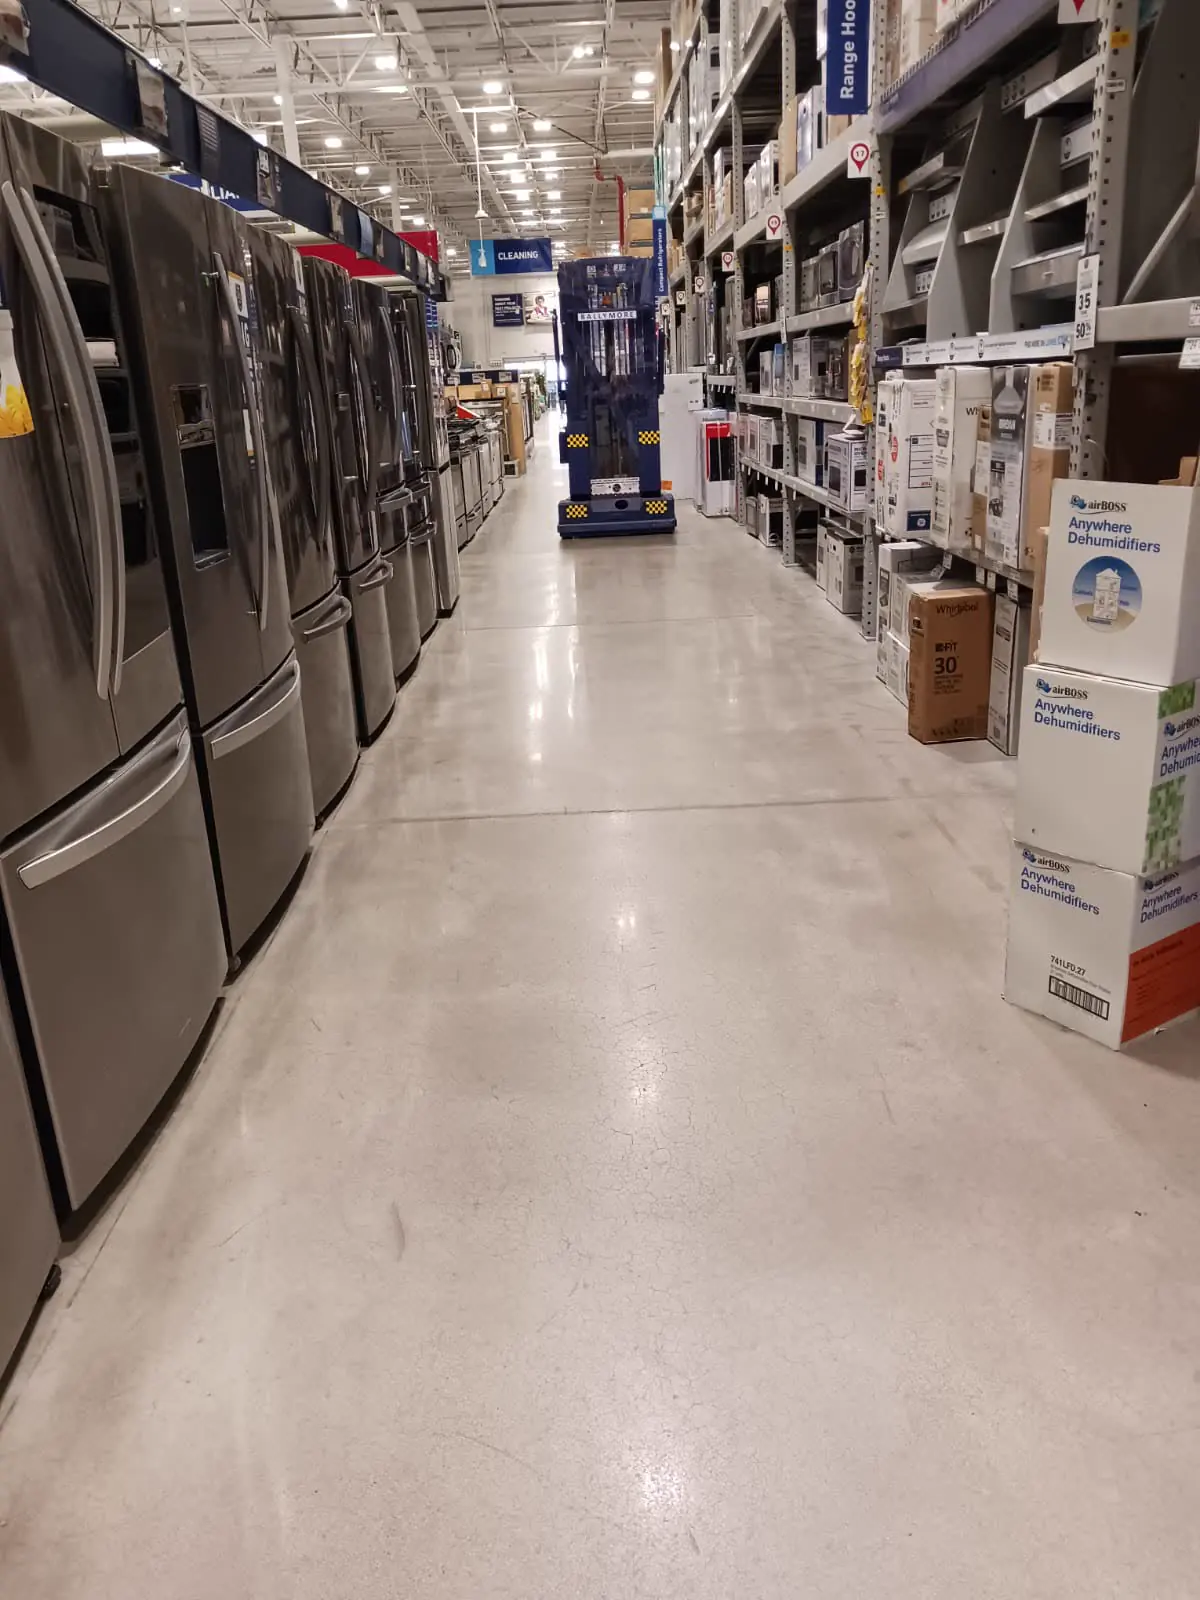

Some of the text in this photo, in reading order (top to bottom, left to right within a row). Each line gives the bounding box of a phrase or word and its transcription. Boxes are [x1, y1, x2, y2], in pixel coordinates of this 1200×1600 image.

[840, 41, 858, 99] Range
[498, 250, 539, 260] CLEANING
[1079, 293, 1091, 310] 35
[580, 311, 634, 320] BALLYMORE
[1088, 500, 1127, 512] airBOSS
[1069, 516, 1132, 534] Anywhere
[1068, 531, 1161, 553] Dehumidifiers
[935, 602, 979, 617] Whirlpool
[934, 656, 957, 674] 30
[1052, 685, 1088, 700] airBOSS
[1035, 698, 1093, 720] Anywhere
[1034, 711, 1120, 741] Dehumidifiers
[1038, 857, 1070, 873] airBOSS
[1021, 866, 1075, 893] Anywhere
[1021, 878, 1100, 915] Dehumidifiers
[1142, 885, 1182, 911] Anywhere
[1140, 891, 1198, 923] Dehumidifiers
